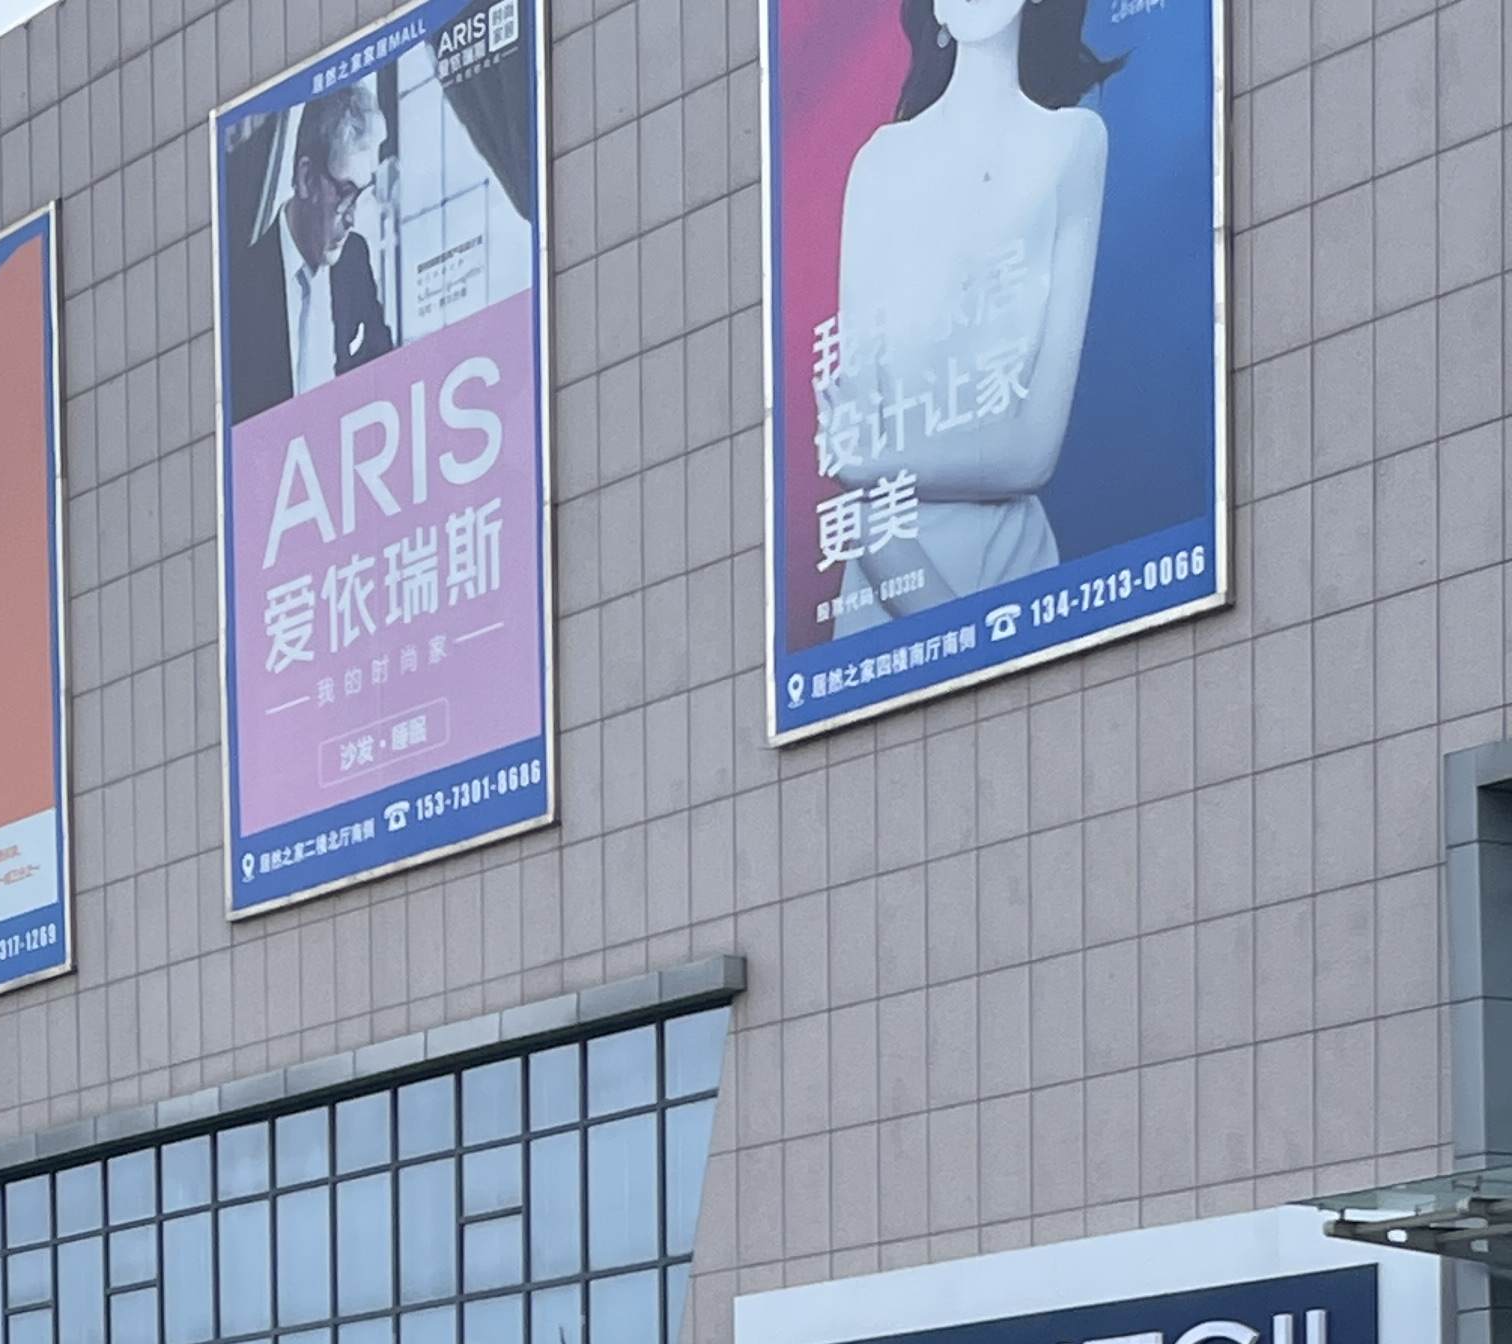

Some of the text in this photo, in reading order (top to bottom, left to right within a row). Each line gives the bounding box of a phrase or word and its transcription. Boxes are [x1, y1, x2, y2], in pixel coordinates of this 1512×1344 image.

[437, 12, 487, 58] ARIS
[812, 337, 1030, 478] 设计让家
[262, 356, 503, 569] ARIS
[816, 469, 920, 572] 更美
[264, 498, 503, 673] 爱依瑞斯
[1030, 546, 1206, 627] 134-7213-0066
[415, 759, 541, 821] 153-7301-8686
